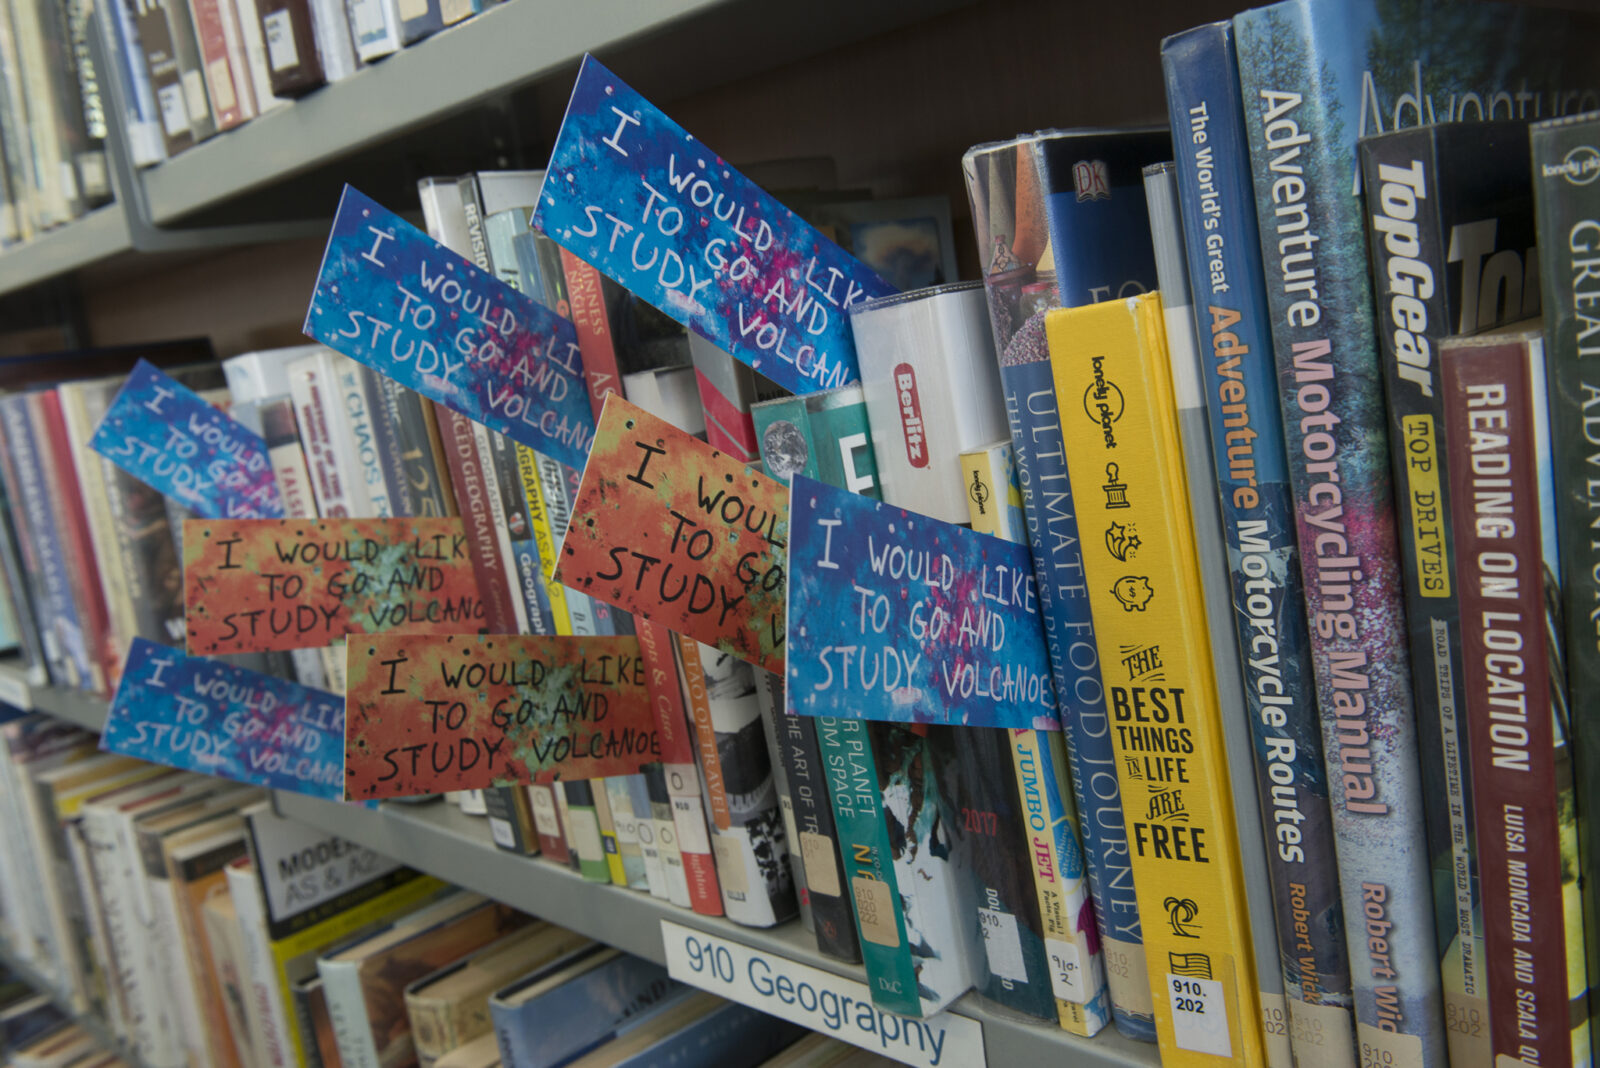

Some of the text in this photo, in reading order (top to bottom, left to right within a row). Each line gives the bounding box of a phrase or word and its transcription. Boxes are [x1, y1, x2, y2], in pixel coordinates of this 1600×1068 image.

[602, 106, 873, 310] I WOULD LIK
[1077, 163, 1106, 193] DK
[464, 203, 491, 274] REVISIO
[573, 205, 712, 304] STUDY
[642, 181, 828, 335] TO GO AND
[361, 226, 395, 268] I
[420, 260, 516, 335] WOULD
[546, 335, 588, 379] LI
[568, 270, 588, 326] NAGLE
[1373, 159, 1434, 397] TopGear
[339, 311, 463, 383] STUDY
[398, 286, 568, 402] TO GO AND
[144, 384, 268, 473] I WOULD
[897, 373, 924, 461] Berlitz
[1007, 391, 1024, 440] THE
[1091, 356, 1118, 450] lonely planet
[114, 436, 214, 493] STUDY
[165, 423, 250, 486] TO GO
[477, 434, 505, 529] GEOGRAPHY
[1189, 101, 1306, 863] The World's Great Adventure Motorcycle Routes
[1260, 89, 1390, 815] Adventure Motorcycling Manual
[462, 460, 498, 571] GEOGRAPHY
[627, 441, 785, 549] I WOUL
[972, 469, 986, 515] lonely planet
[1016, 446, 1042, 549] WORLD'S
[1408, 421, 1444, 591] TOP DRIVES
[216, 538, 243, 570] I
[275, 538, 379, 564] WOULD
[535, 529, 550, 553] AS
[670, 511, 784, 592] TO GO
[817, 518, 1036, 614] I WOULD LIKE
[261, 566, 444, 602] TO GO AND
[597, 547, 744, 627] STUDY
[1034, 556, 1052, 608] BEST
[1466, 383, 1531, 772] READING ON LOCATION
[218, 604, 341, 641] STUDY
[854, 585, 1005, 652] TO GO AND
[1435, 628, 1447, 658] ROAD
[146, 657, 174, 688] I
[193, 672, 278, 713] WOULD
[380, 655, 645, 695] I WOULD LIKE
[814, 645, 921, 697] STUDY
[1027, 388, 1143, 942] ULTIMATE FOOD JOURNEY
[1044, 615, 1068, 697] DISHES
[1121, 645, 1164, 682] THE
[174, 695, 321, 753] TO GO AND
[424, 692, 608, 733] TO GO AND
[652, 667, 674, 743] & Cases
[687, 657, 703, 699] TAO
[696, 706, 711, 734] OF
[786, 714, 803, 740] HE
[1059, 703, 1071, 717] &
[1111, 686, 1185, 724] BEST
[128, 721, 232, 758] STUDY
[378, 727, 662, 781] STUDY VOLCANOE
[792, 745, 810, 780] ART
[1063, 725, 1086, 803] WHERE
[1116, 725, 1194, 754] THINGS
[1126, 756, 1190, 784] IN LIFE
[799, 786, 816, 809] OF
[828, 754, 855, 819] SPACE
[846, 740, 877, 818] PLANET
[1146, 789, 1185, 820] ARE
[962, 808, 998, 838] 2017
[1017, 743, 1056, 884] JUMBO JET
[1079, 810, 1092, 839] TO
[1133, 822, 1210, 864] FREE
[1085, 845, 1100, 886] EAT
[1288, 882, 1314, 953] Robert
[1361, 882, 1399, 980] Robert
[1503, 803, 1540, 1041] LUISA MONCADA AND SCALA
[685, 935, 735, 984] 910
[748, 956, 946, 1066] Geography
[1059, 973, 1073, 986] 2
[1172, 979, 1208, 998] 910.
[1176, 997, 1206, 1014] 202
